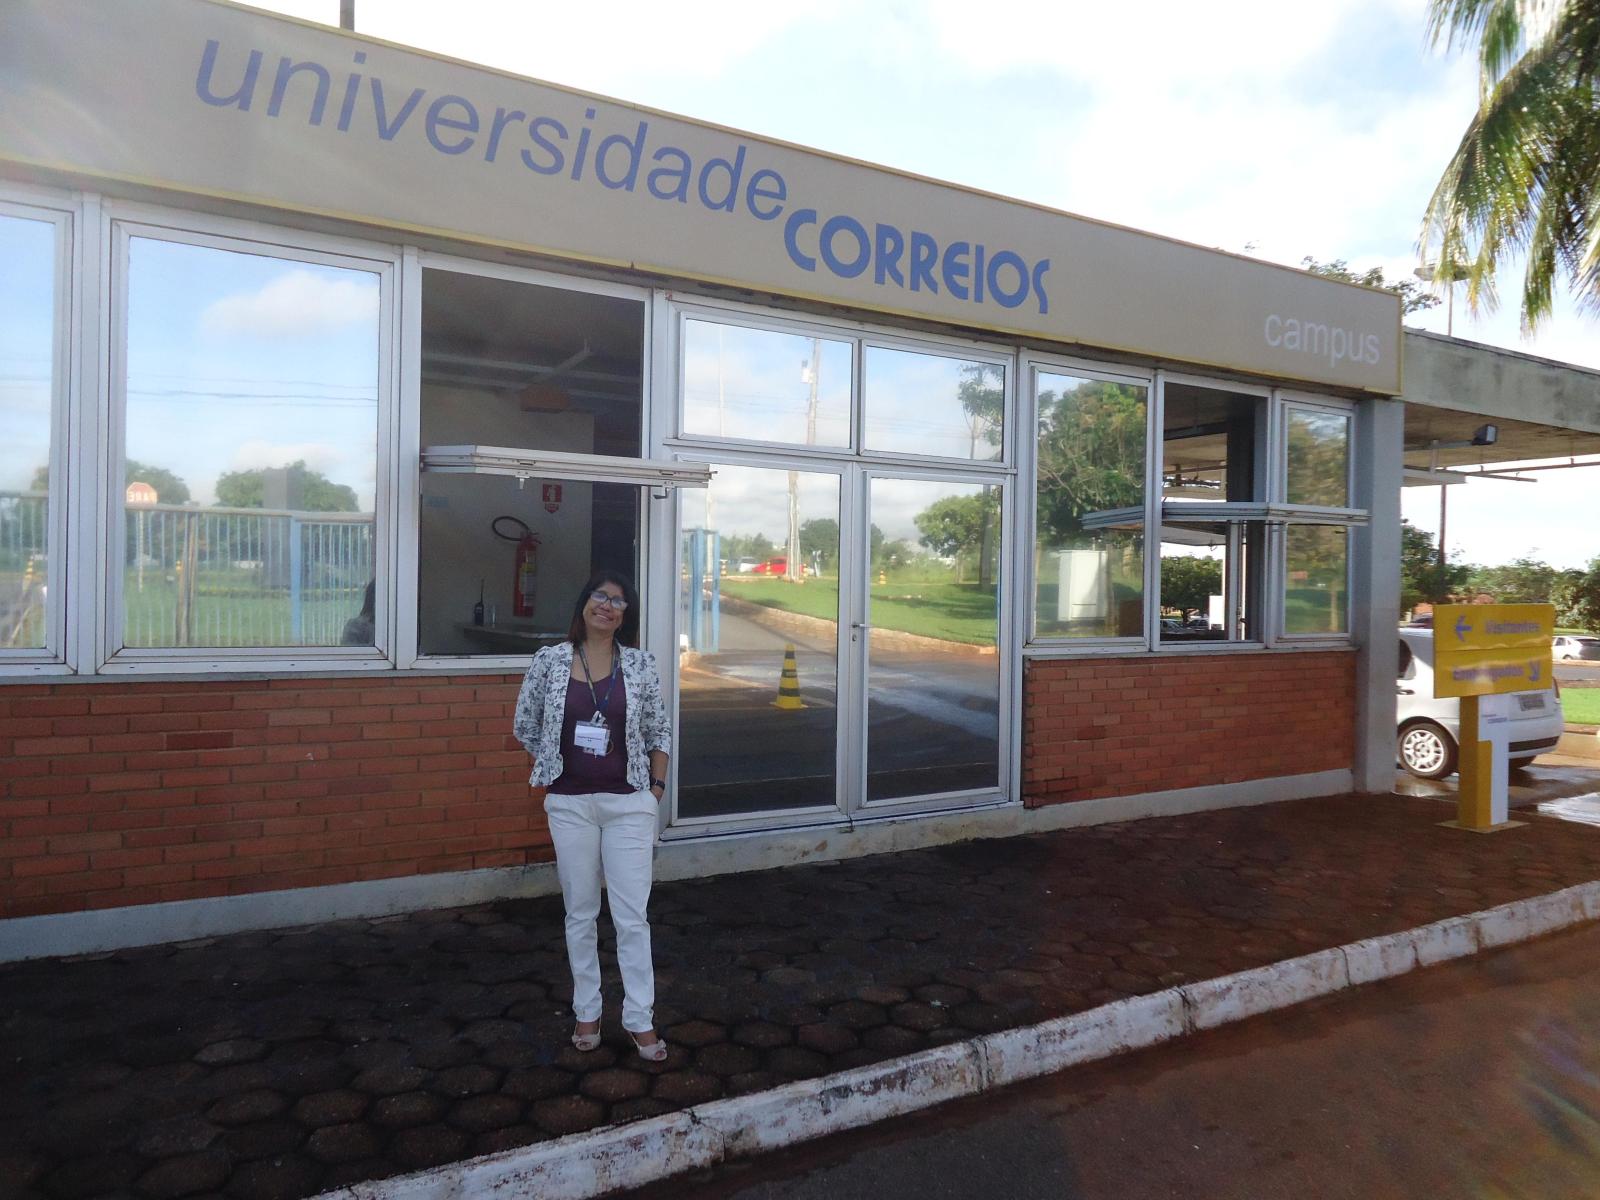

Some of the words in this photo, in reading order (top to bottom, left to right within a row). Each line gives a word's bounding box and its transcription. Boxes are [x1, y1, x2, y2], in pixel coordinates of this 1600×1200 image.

[195, 39, 788, 222] universidade
[783, 208, 1050, 315] CORREIOS
[1264, 314, 1380, 368] campus
